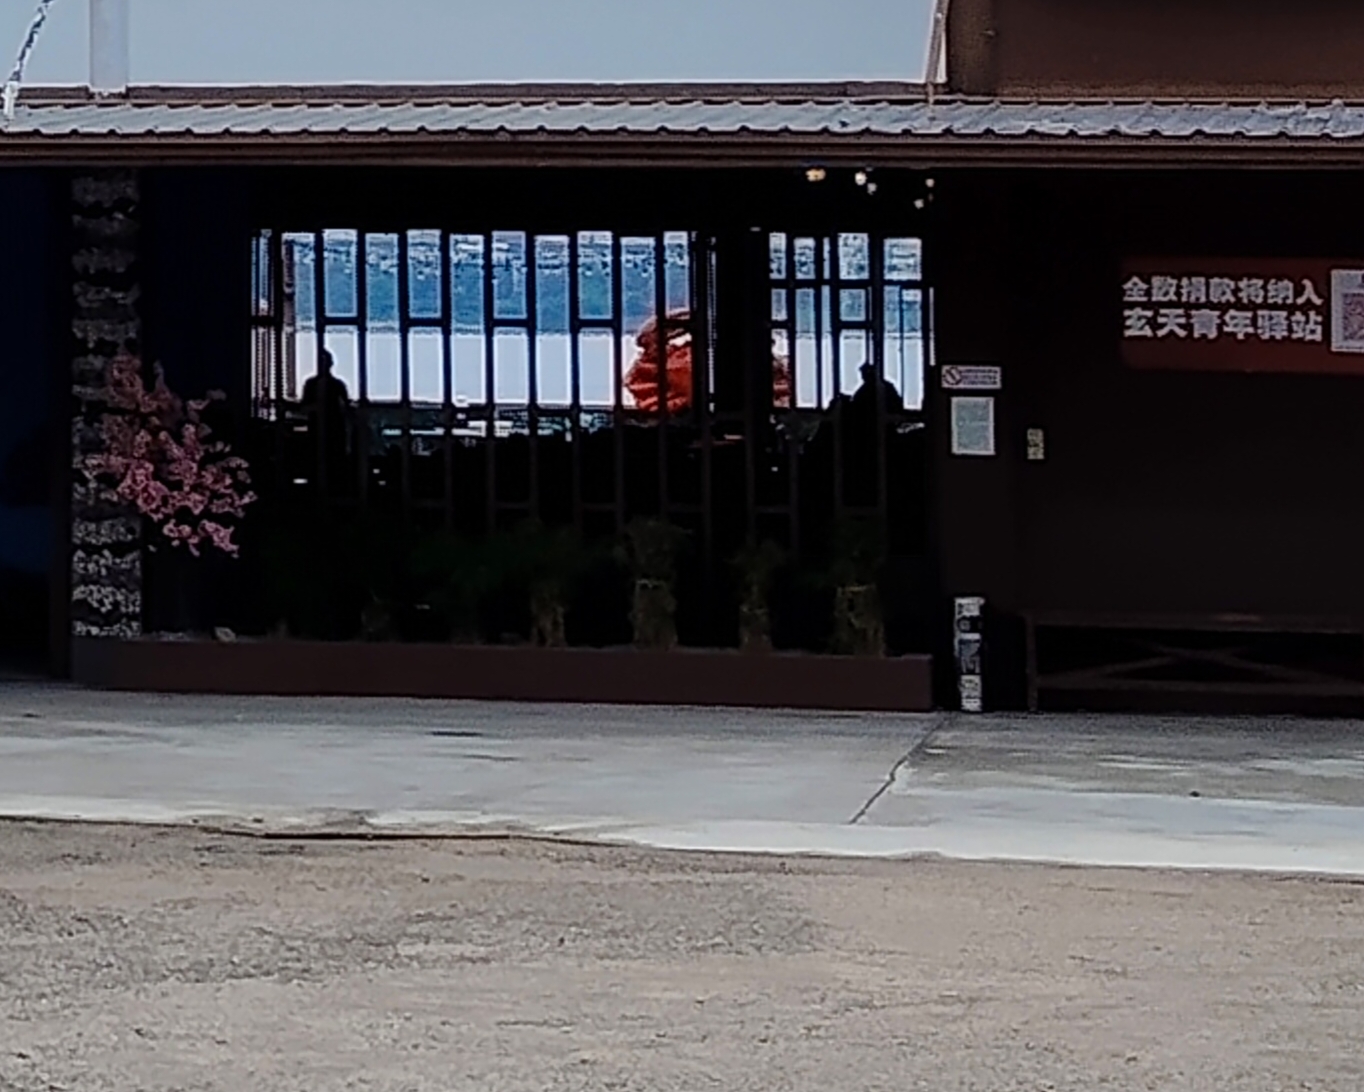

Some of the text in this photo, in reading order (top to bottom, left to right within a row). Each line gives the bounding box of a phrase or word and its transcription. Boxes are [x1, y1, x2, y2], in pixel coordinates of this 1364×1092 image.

[1123, 307, 1324, 342] 玄天青年驿站
